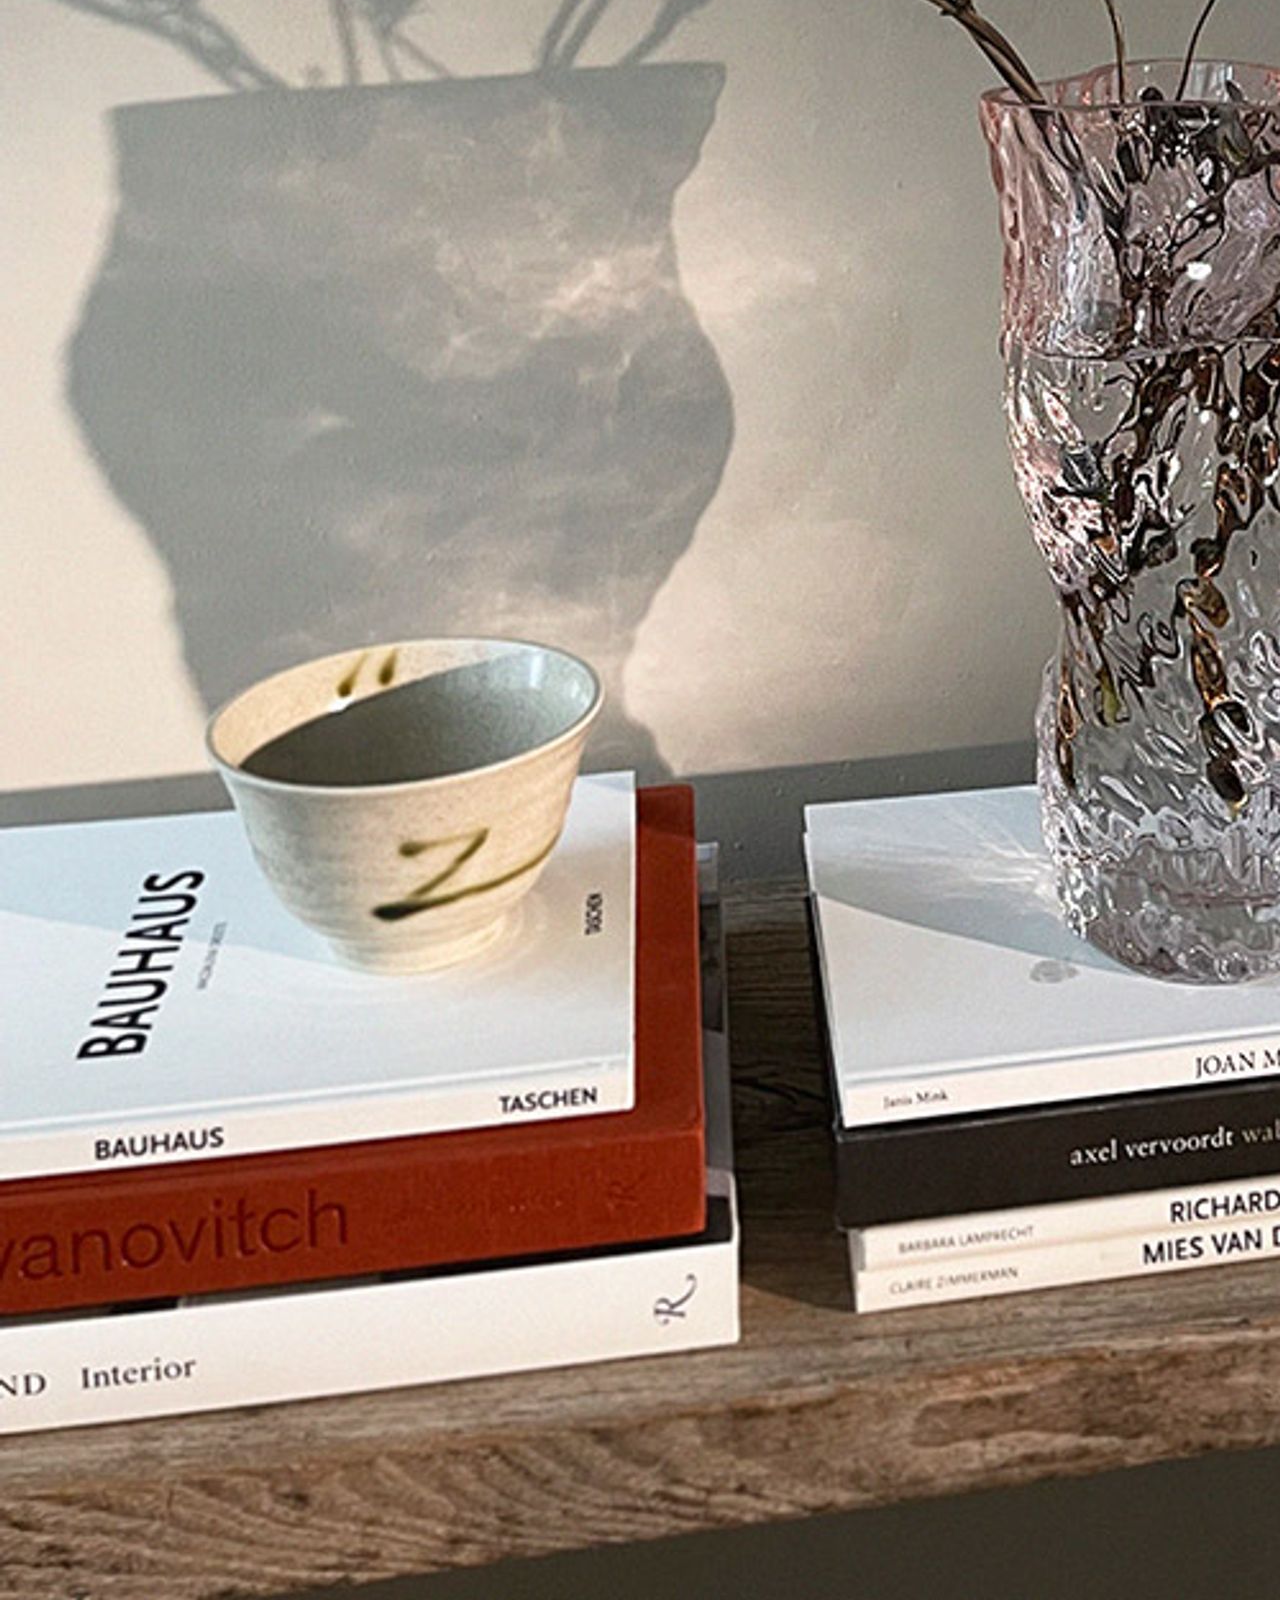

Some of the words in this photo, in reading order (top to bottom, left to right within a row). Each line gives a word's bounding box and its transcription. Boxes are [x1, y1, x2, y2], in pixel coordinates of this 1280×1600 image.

[76, 869, 205, 1060] BAUHAUS
[1195, 1051, 1256, 1080] JOAN
[500, 1086, 598, 1114] TASCHEN
[94, 1127, 225, 1161] BAUHAUS
[1068, 1137, 1118, 1168] axel
[1124, 1122, 1235, 1160] vervoordt
[1142, 1237, 1205, 1266] MIES
[1213, 1227, 1263, 1255] VAN
[81, 1358, 196, 1390] Interior
